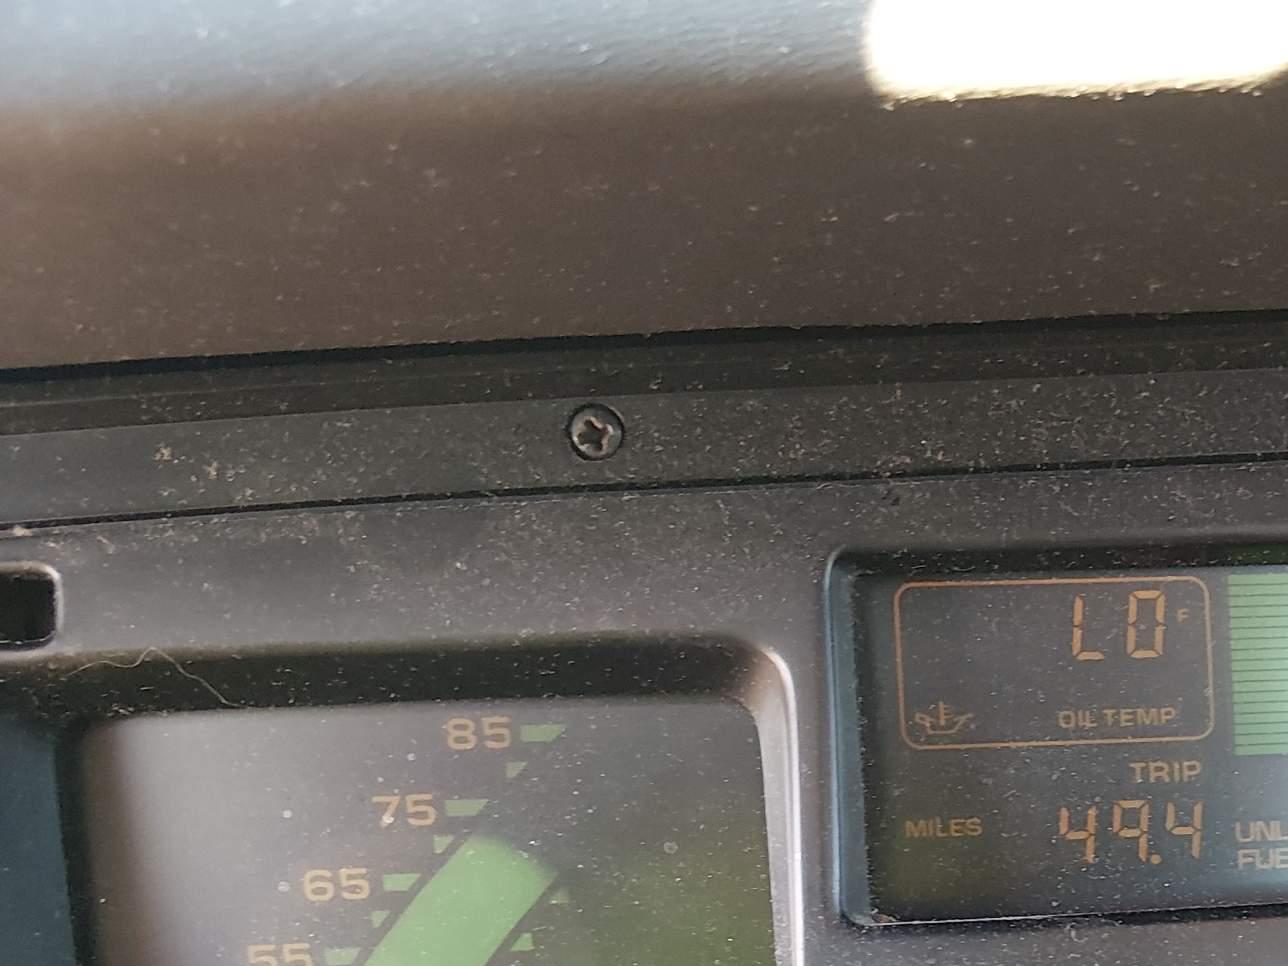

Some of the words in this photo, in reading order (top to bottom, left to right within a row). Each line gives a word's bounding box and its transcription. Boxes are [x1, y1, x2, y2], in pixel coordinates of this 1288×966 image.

[446, 717, 512, 750] 85
[1059, 709, 1098, 730] OIL
[1103, 706, 1178, 729] TEMP
[1129, 760, 1202, 784] TRIP
[373, 793, 437, 827] 75
[905, 818, 983, 839] MILES
[1058, 799, 1203, 866] 49.4
[302, 868, 370, 901] 65
